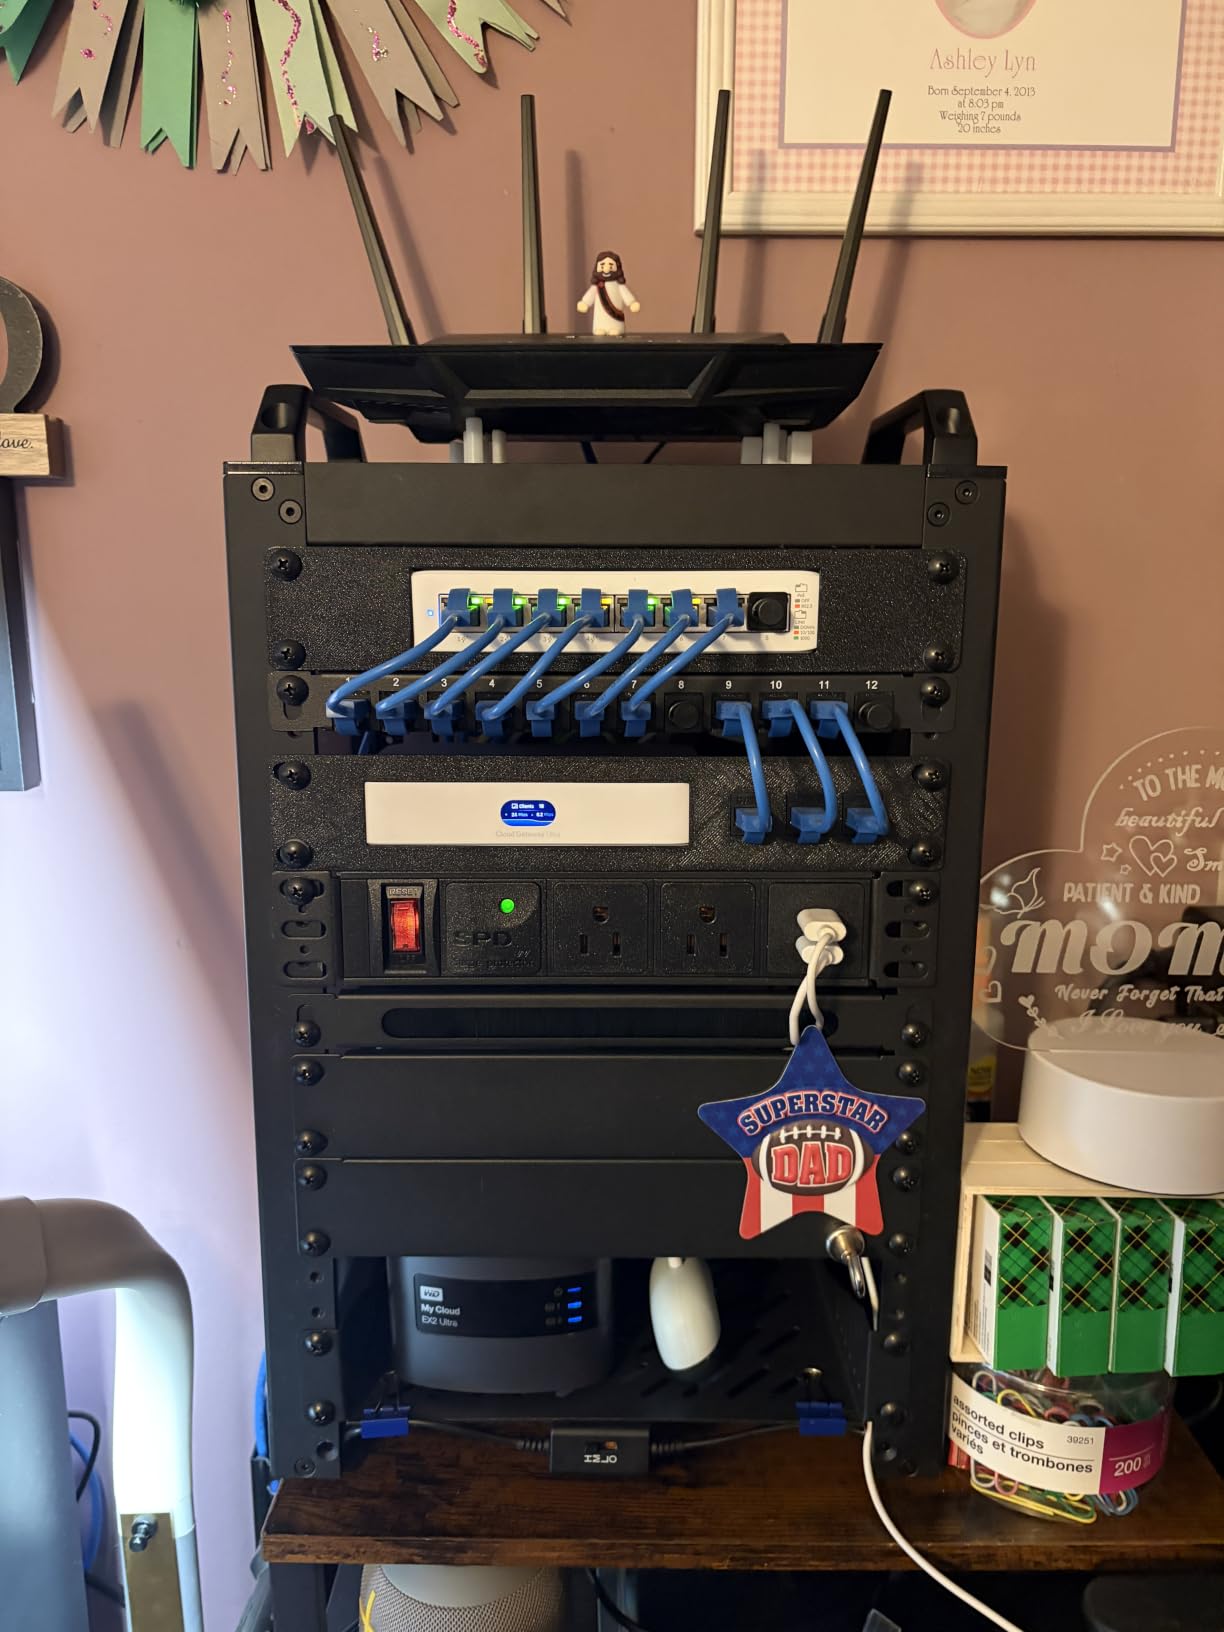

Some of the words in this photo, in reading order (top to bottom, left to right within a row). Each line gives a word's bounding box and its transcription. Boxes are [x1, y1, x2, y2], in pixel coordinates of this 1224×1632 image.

[929, 47, 997, 78] Ashley
[1004, 48, 1036, 79] Lyn
[927, 85, 949, 96] Born
[951, 86, 1003, 99] September
[1014, 86, 1036, 97] 2013
[957, 98, 966, 108] at
[968, 98, 989, 109] 8:03
[991, 101, 1004, 112] pm
[939, 110, 980, 125] Weighing
[981, 111, 986, 121] 7
[987, 111, 1022, 125] pounds
[957, 123, 971, 133] 20
[972, 123, 1001, 134] inches
[393, 678, 400, 688] 2
[441, 678, 448, 688] 3
[488, 678, 495, 688] 4
[536, 679, 543, 689] 5
[631, 679, 637, 689] 7
[678, 679, 685, 690] 8
[725, 679, 732, 690] 9
[770, 680, 783, 690] 10
[818, 680, 830, 690] 11
[865, 680, 879, 690] 12
[1133, 774, 1162, 801] TO
[1164, 764, 1202, 791] THE
[1115, 807, 1224, 836] beautiful
[389, 887, 418, 896] RESET
[1063, 882, 1134, 904] PATIENT
[1139, 883, 1153, 904] &
[1158, 883, 1201, 905] KIND
[452, 930, 513, 948] SPD
[1054, 984, 1108, 1001] Never
[1116, 984, 1181, 1008] Forget
[1184, 985, 1224, 1002] That
[737, 1091, 888, 1136] SUPERSTAR
[771, 1142, 853, 1187] DAD
[423, 1289, 441, 1298] WD
[421, 1303, 434, 1314] My
[435, 1305, 461, 1316] Cloud
[421, 1315, 438, 1325] EX2
[439, 1317, 458, 1327] Ultra
[953, 1395, 1005, 1436] assorted
[1009, 1430, 1044, 1450] clips
[951, 1424, 984, 1455] variés
[952, 1411, 988, 1444] pinces
[992, 1441, 1006, 1454] et
[1010, 1447, 1093, 1473] trombones
[1066, 1436, 1094, 1445] 39251
[1113, 1456, 1142, 1477] 200
